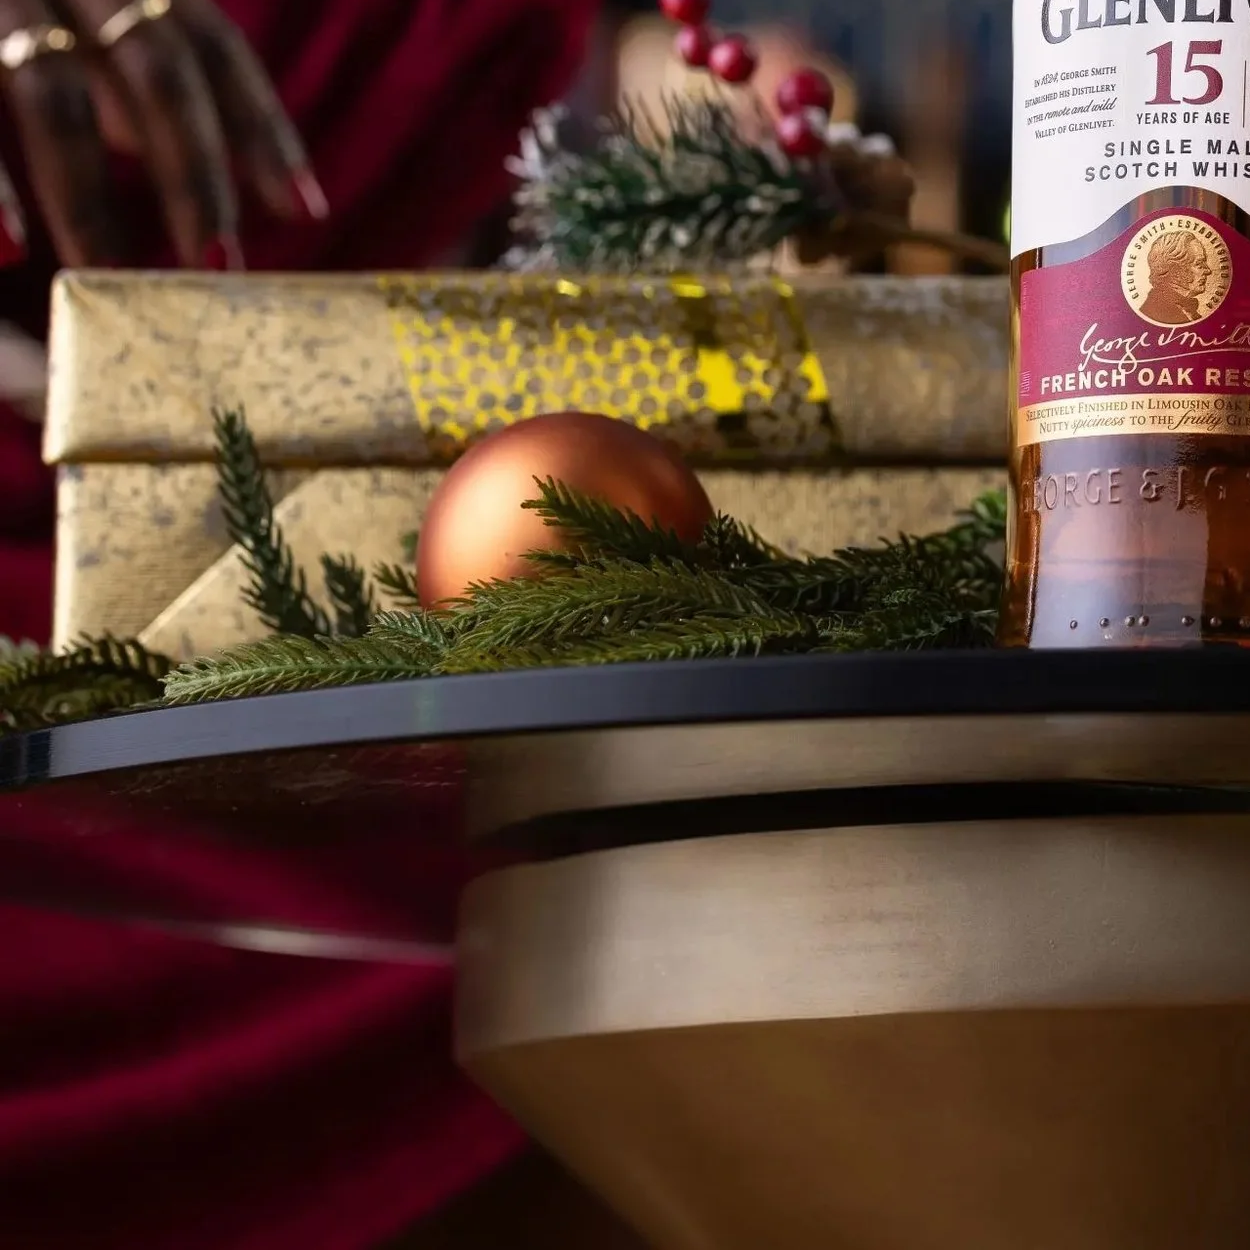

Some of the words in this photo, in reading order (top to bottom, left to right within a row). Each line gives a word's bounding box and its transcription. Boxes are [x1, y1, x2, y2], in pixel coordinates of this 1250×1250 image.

[1034, 79, 1041, 88] IN
[1060, 69, 1089, 81] GEORGE
[1091, 66, 1117, 76] SMITH
[1145, 39, 1223, 105] 15
[1024, 92, 1058, 109] ESTABLISHED
[1059, 89, 1070, 99] HIS
[1072, 83, 1116, 96] DISTILLERY
[1027, 117, 1033, 125] IN
[1033, 113, 1044, 123] THE
[1044, 106, 1071, 120] remote
[1071, 99, 1094, 115] and
[1091, 97, 1118, 113] wild
[1136, 111, 1178, 125] YEARS
[1183, 111, 1199, 124] OF
[1205, 111, 1230, 125] AGE
[1035, 127, 1056, 139] VALLEY
[1057, 125, 1067, 134] OF
[1068, 119, 1115, 132] GLENLIVET.
[1104, 139, 1193, 158] SINGLE
[1084, 161, 1179, 183] SCOTCH
[1126, 254, 1141, 300] GEORGE
[1134, 222, 1166, 250] SMITH
[1177, 219, 1230, 279] ESTABLISHED
[1205, 284, 1226, 310] 1824
[1078, 323, 1150, 374] George
[1041, 369, 1126, 395] FRENCH
[1138, 367, 1194, 386] OAK
[1026, 405, 1075, 422] SELECTIVELY
[1078, 401, 1128, 414] FINISHED
[1131, 400, 1144, 410] IN
[1147, 398, 1210, 411] LIMOUSIN
[1214, 398, 1243, 412] OAK
[1039, 420, 1069, 435] NUTTY
[1071, 414, 1126, 435] spiciness
[1130, 415, 1146, 425] TO
[1149, 415, 1174, 425] THE
[1167, 409, 1223, 432] fruity
